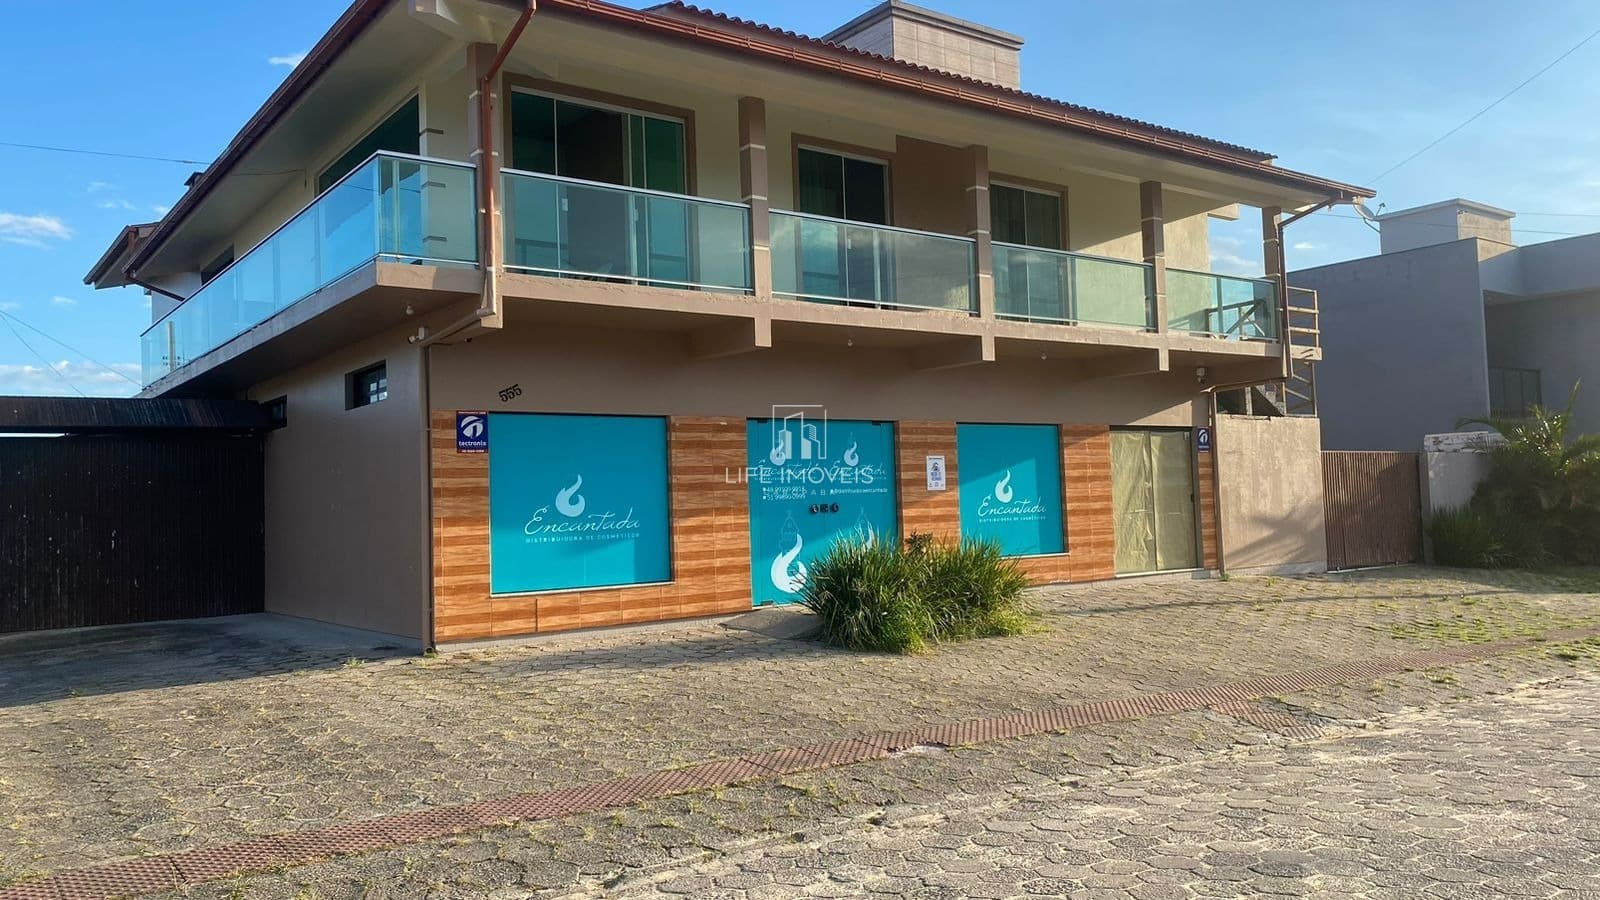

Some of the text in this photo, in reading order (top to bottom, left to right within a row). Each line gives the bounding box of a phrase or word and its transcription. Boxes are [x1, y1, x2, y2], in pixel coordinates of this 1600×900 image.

[498, 384, 522, 402] 555
[976, 494, 1047, 517] Encantada
[524, 505, 641, 535] Encantada
